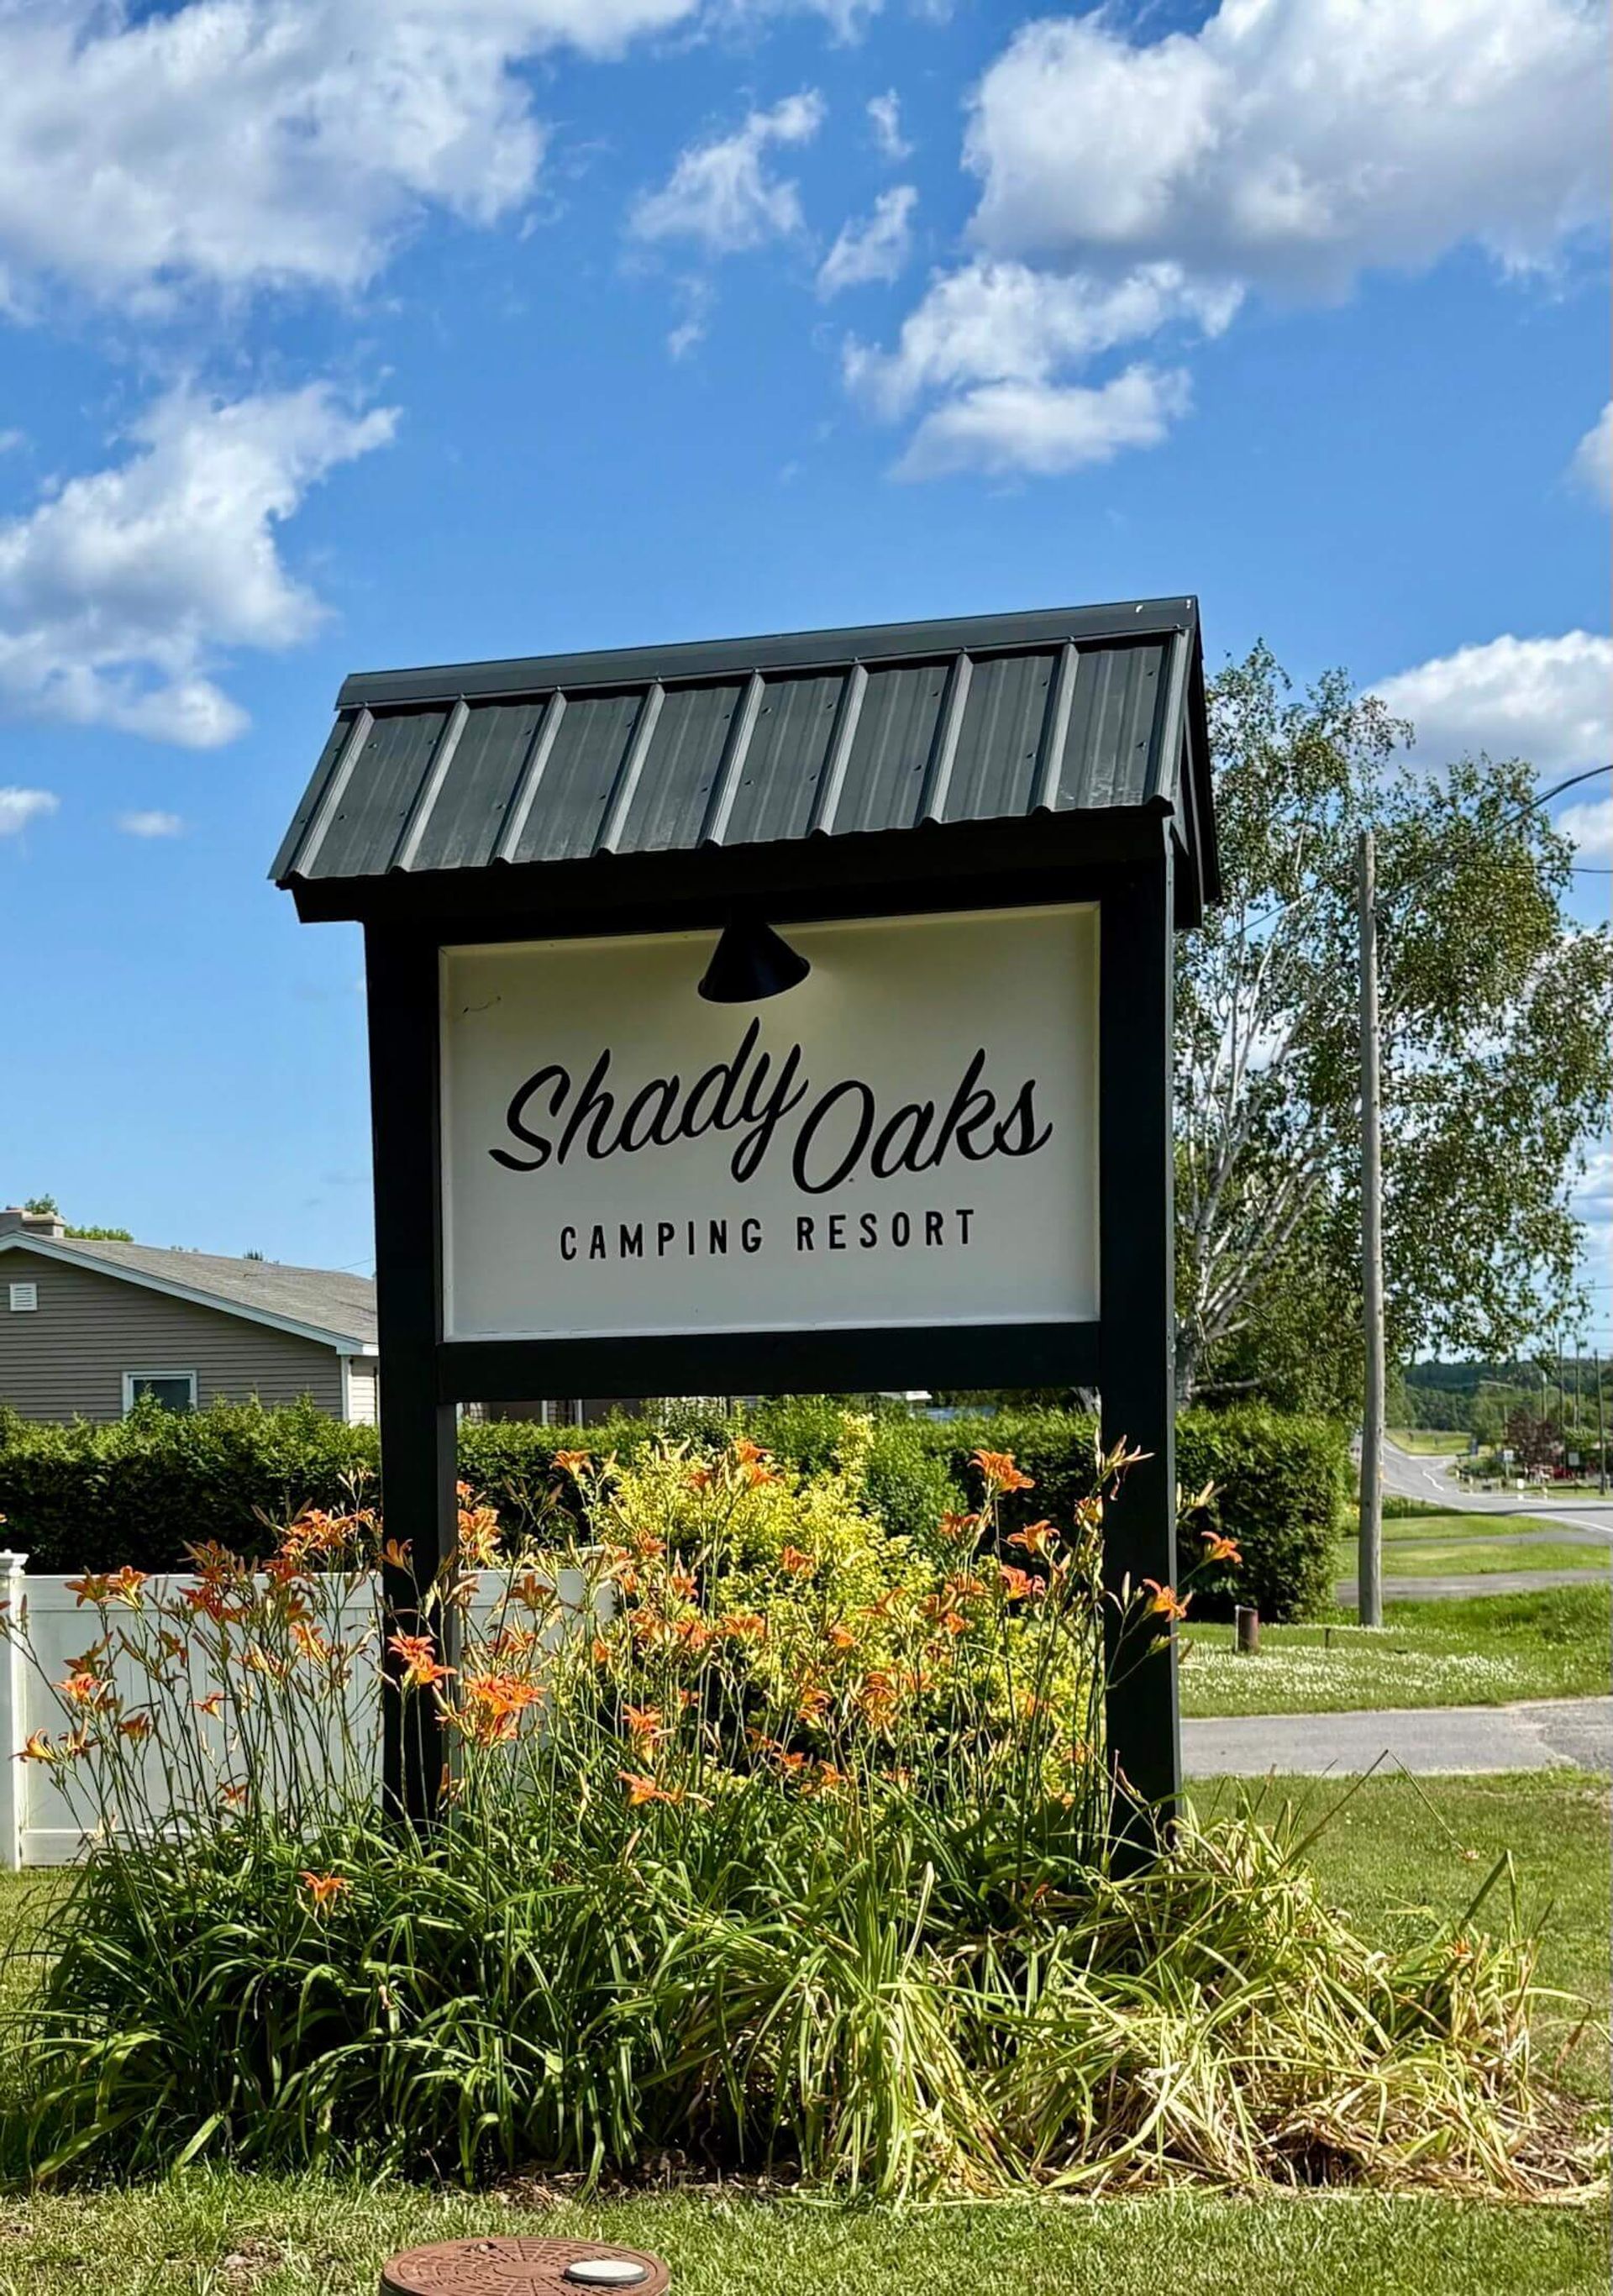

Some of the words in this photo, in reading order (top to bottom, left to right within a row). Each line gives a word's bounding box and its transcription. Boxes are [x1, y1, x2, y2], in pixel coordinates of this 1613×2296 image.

[487, 1016, 809, 1184] Shady
[791, 1047, 1053, 1195] Oaks
[560, 1217, 764, 1262] CAMPING
[796, 1208, 975, 1253] RESORT
